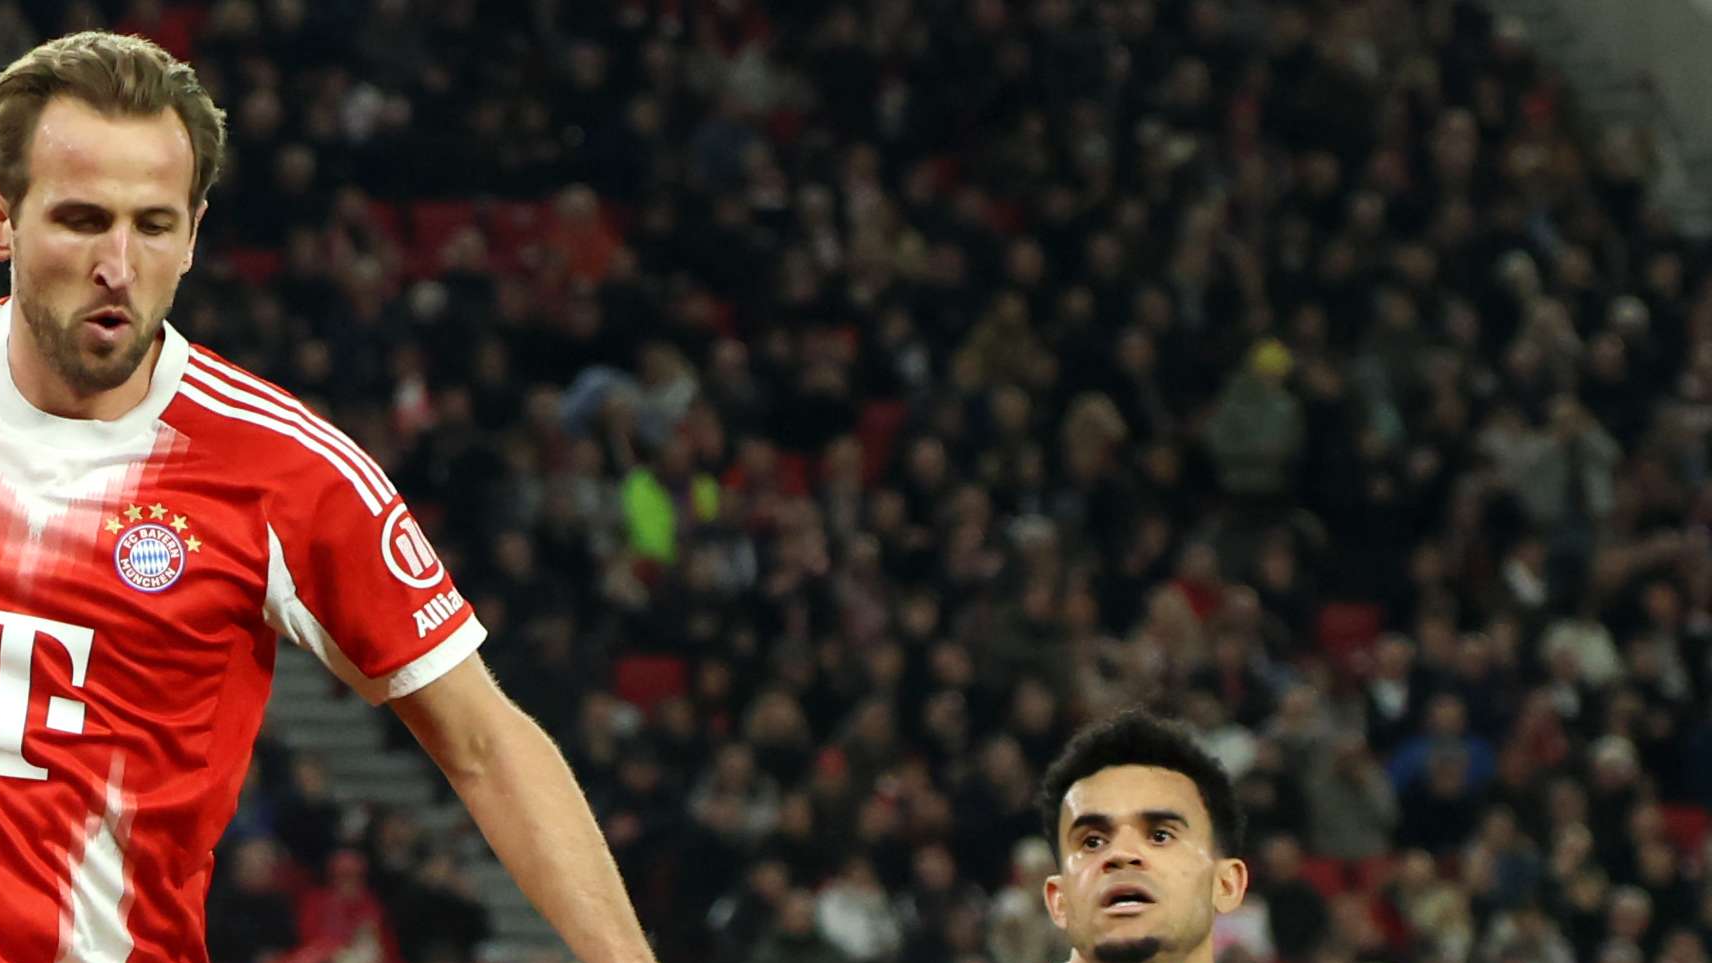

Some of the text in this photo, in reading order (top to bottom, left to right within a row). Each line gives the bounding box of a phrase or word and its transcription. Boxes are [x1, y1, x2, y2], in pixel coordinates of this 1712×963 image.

[123, 529, 179, 558] FC BAYERN
[413, 586, 465, 639] Allia
